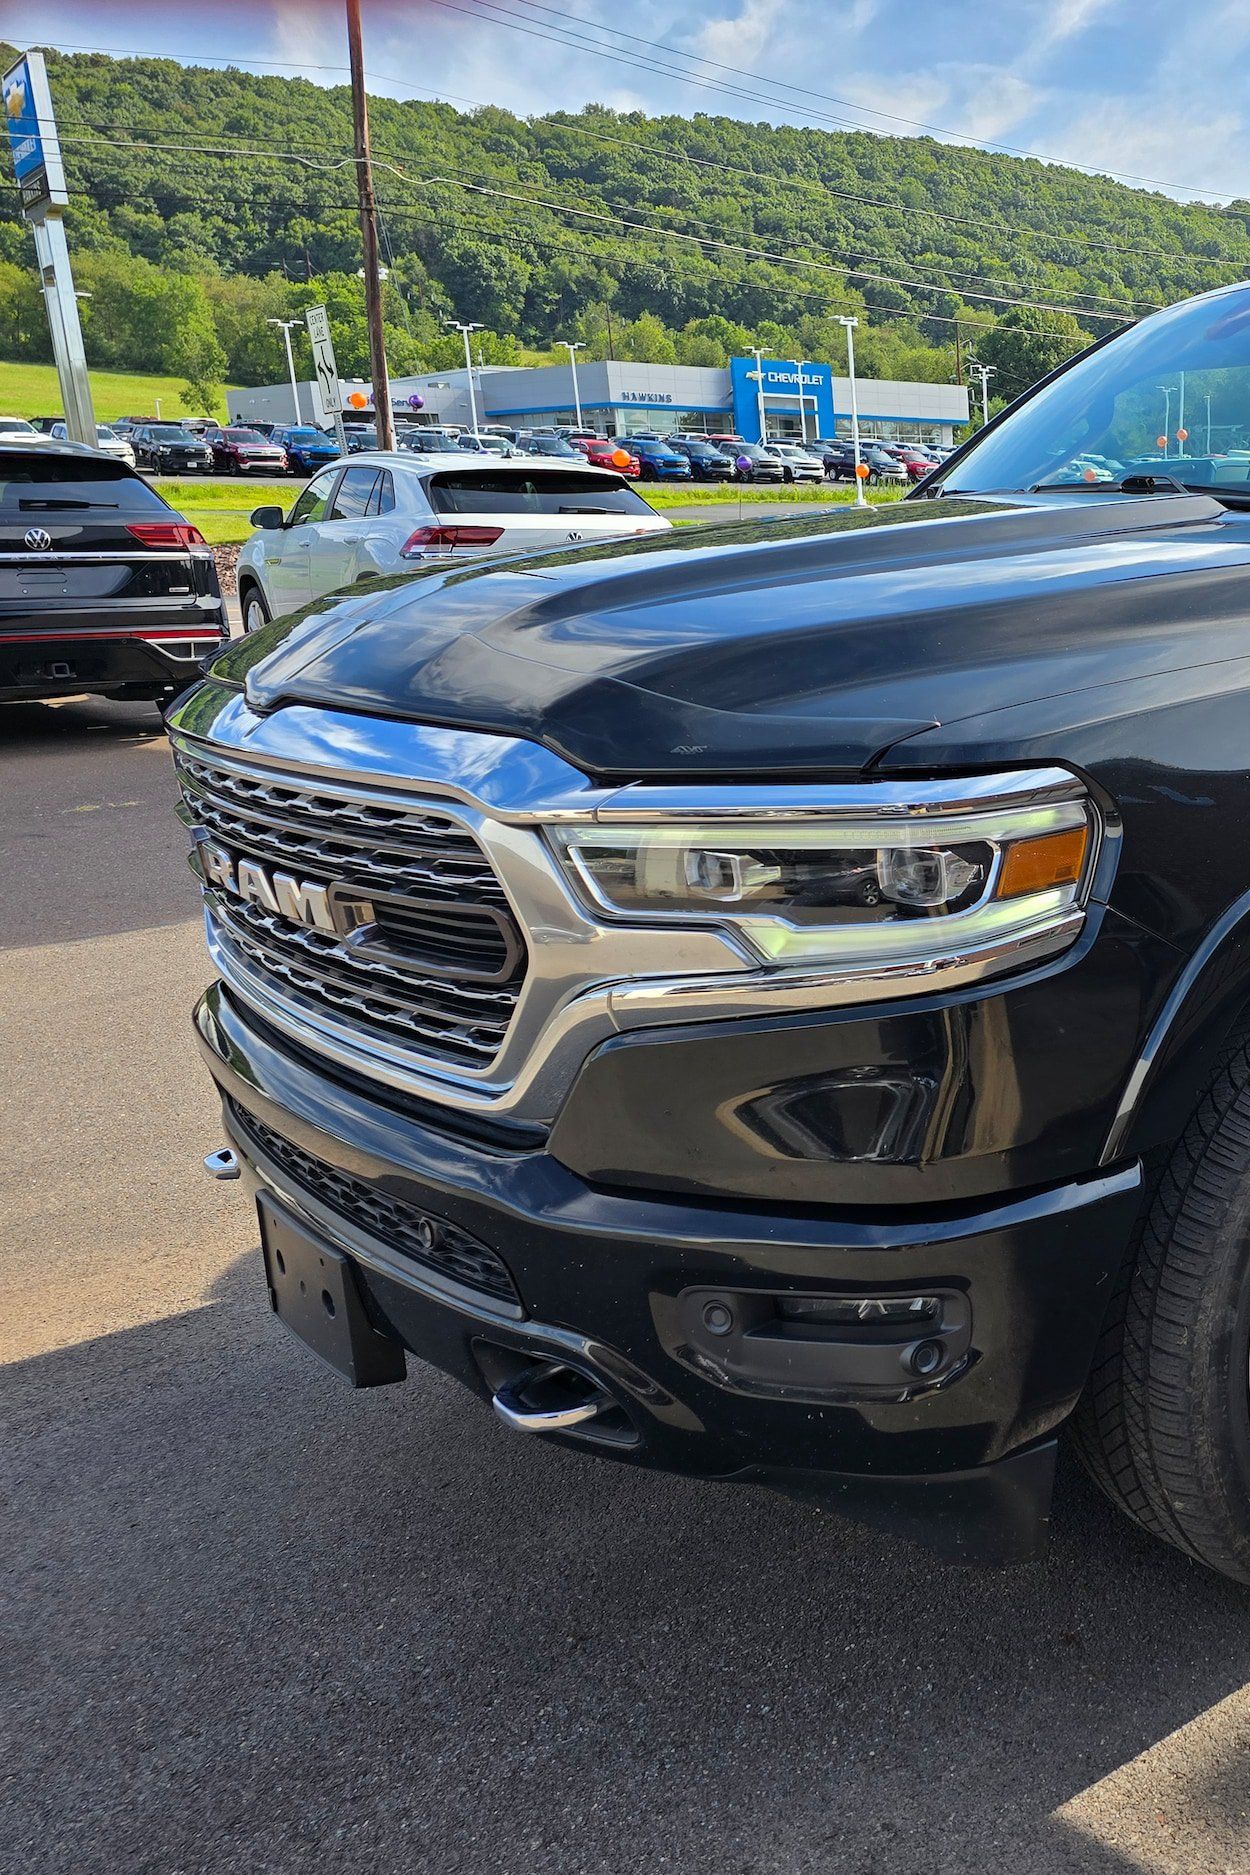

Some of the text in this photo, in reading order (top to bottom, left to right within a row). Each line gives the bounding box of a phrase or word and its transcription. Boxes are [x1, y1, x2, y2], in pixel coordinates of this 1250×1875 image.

[768, 371, 824, 386] CHEVROLET
[621, 391, 673, 403] HAWKINS
[202, 840, 336, 932] RAM
